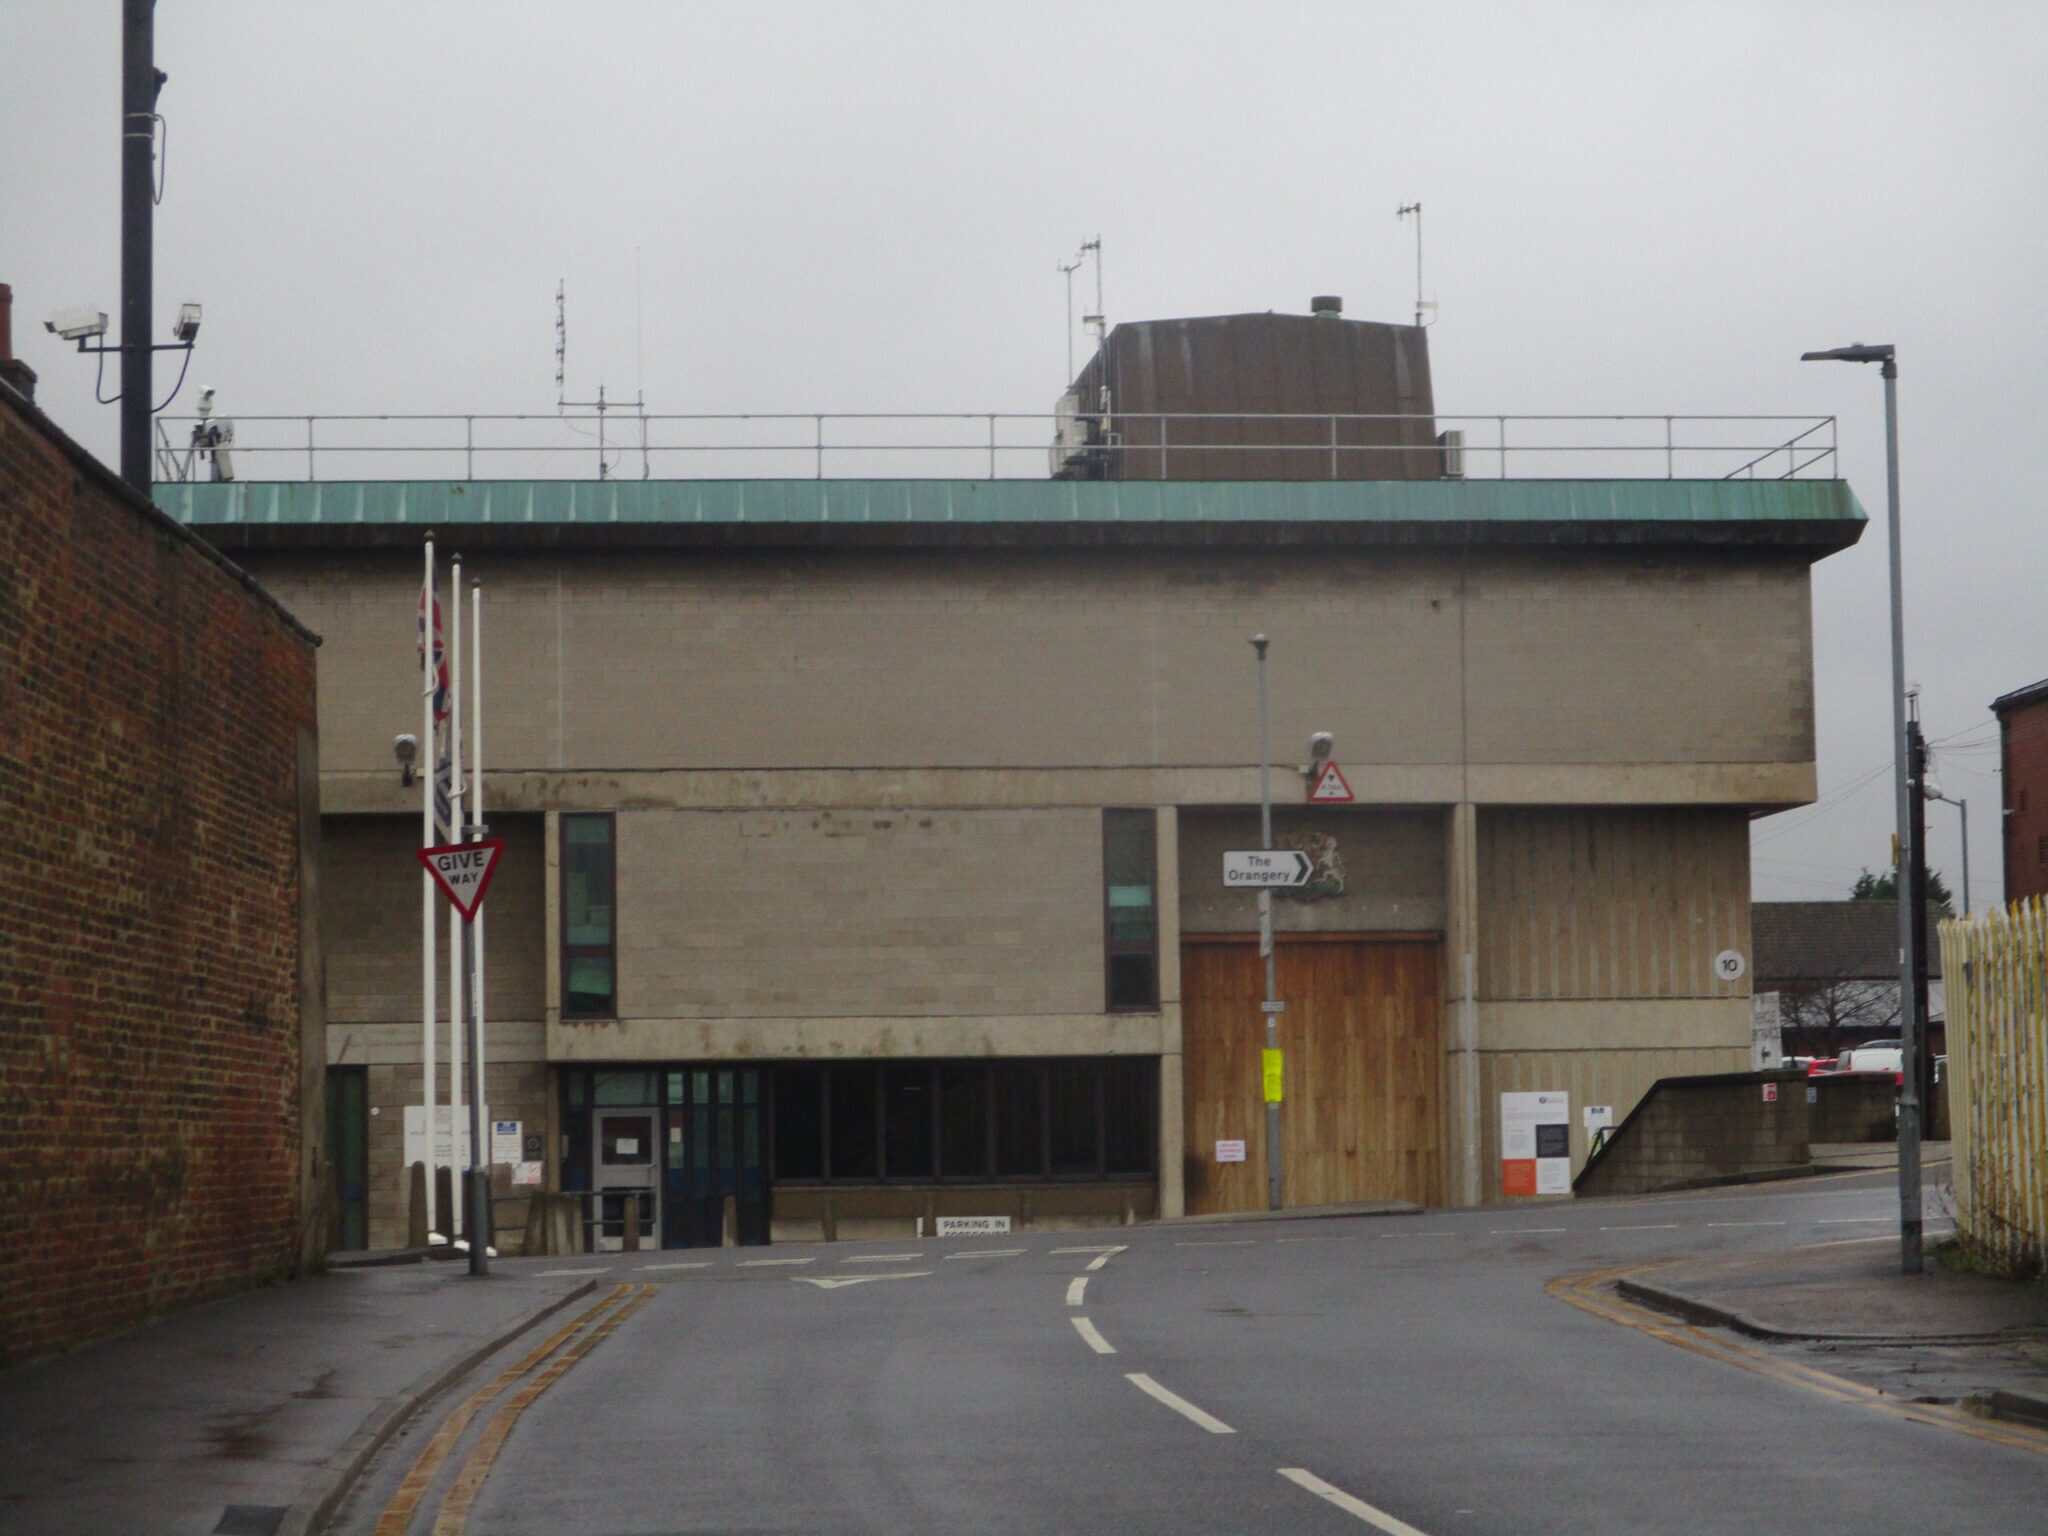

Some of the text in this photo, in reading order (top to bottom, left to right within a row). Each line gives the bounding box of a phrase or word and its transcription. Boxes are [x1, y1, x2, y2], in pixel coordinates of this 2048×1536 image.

[438, 851, 484, 871] GIVE
[1248, 856, 1271, 867] The
[449, 872, 478, 885] WAY
[1228, 870, 1290, 882] Orangery
[1722, 959, 1737, 972] 10
[943, 1220, 1007, 1229] PARKING IN
